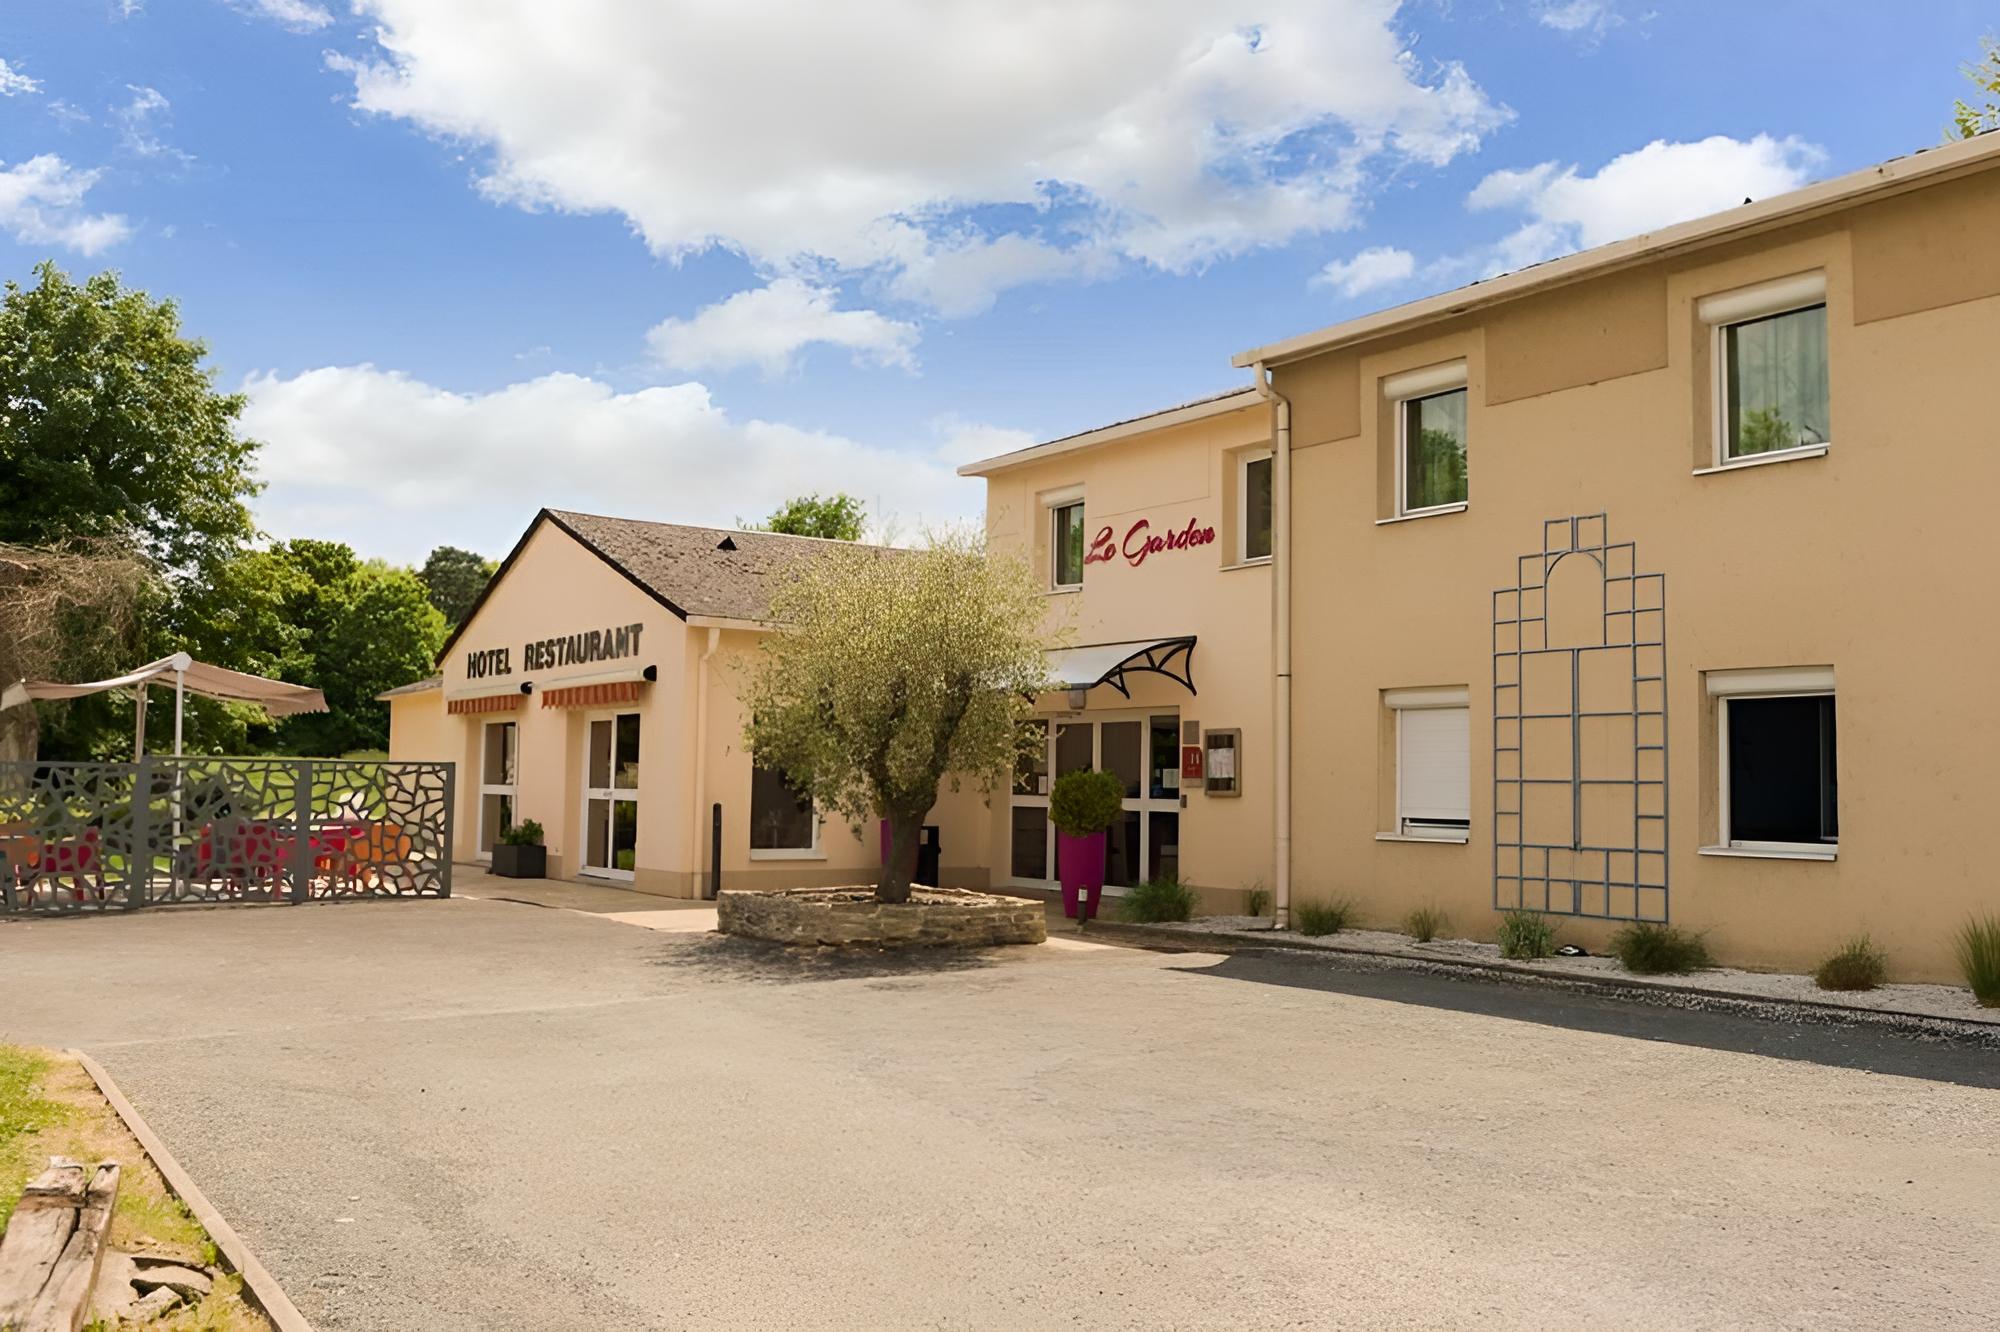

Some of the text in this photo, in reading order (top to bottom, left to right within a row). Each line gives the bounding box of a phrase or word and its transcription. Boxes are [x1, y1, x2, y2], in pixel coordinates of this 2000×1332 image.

[1122, 517, 1215, 567] Garden
[467, 623, 643, 679] HOTEL RESTAURANT
